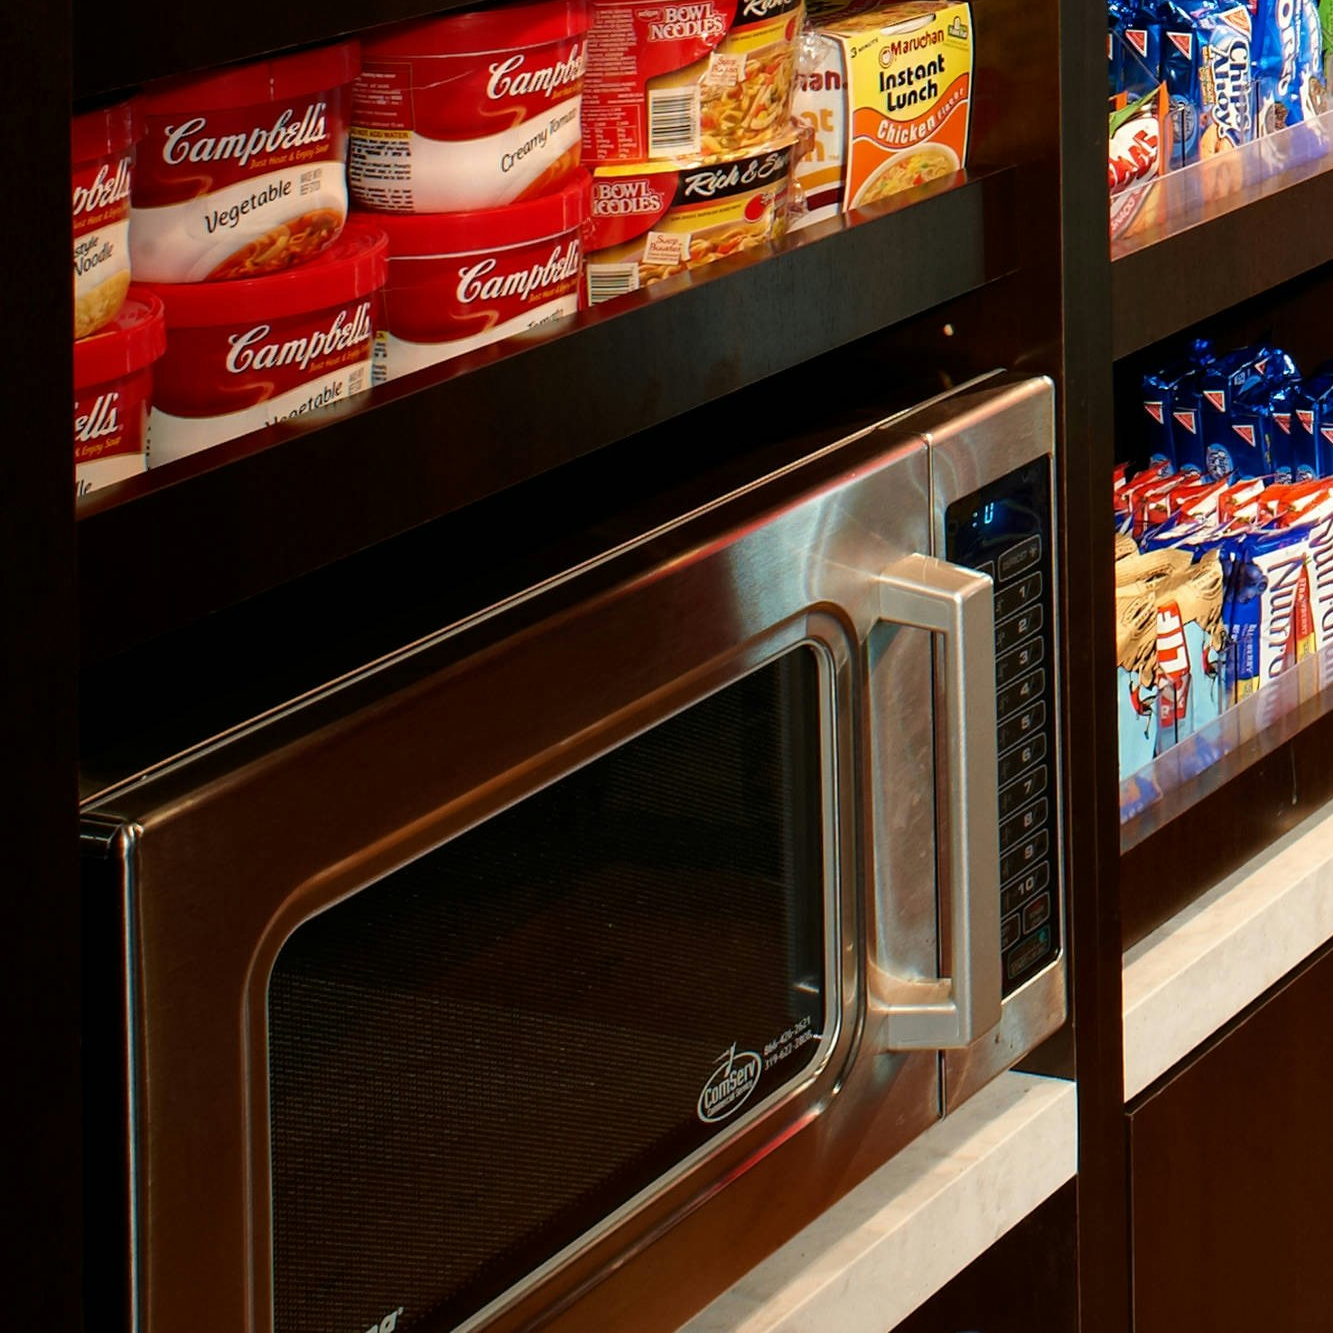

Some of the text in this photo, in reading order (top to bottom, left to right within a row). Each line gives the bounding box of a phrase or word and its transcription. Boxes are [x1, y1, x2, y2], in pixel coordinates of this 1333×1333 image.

[665, 3, 713, 24] BOWL
[650, 17, 725, 42] NOODLES
[891, 28, 945, 61] Maruchan
[880, 55, 945, 94] Instant
[886, 82, 938, 114] Lunch
[1229, 39, 1251, 135] Chips
[162, 102, 329, 168] Campbell's
[877, 112, 936, 145] Chicken
[501, 128, 549, 174] Creamy
[597, 179, 651, 199] BOWL
[685, 165, 757, 198] Rich &
[204, 179, 293, 233] Vegetable
[1019, 585, 1027, 598] 1
[1018, 618, 1028, 633] 2
[1019, 651, 1029, 665] 3
[1020, 682, 1030, 697] 4
[1022, 748, 1032, 762] 6
[1024, 779, 1033, 795] 7
[1024, 812, 1033, 827] 8
[1024, 844, 1034, 859] 9
[1017, 876, 1035, 897] 10
[704, 1059, 756, 1110] ComServ
